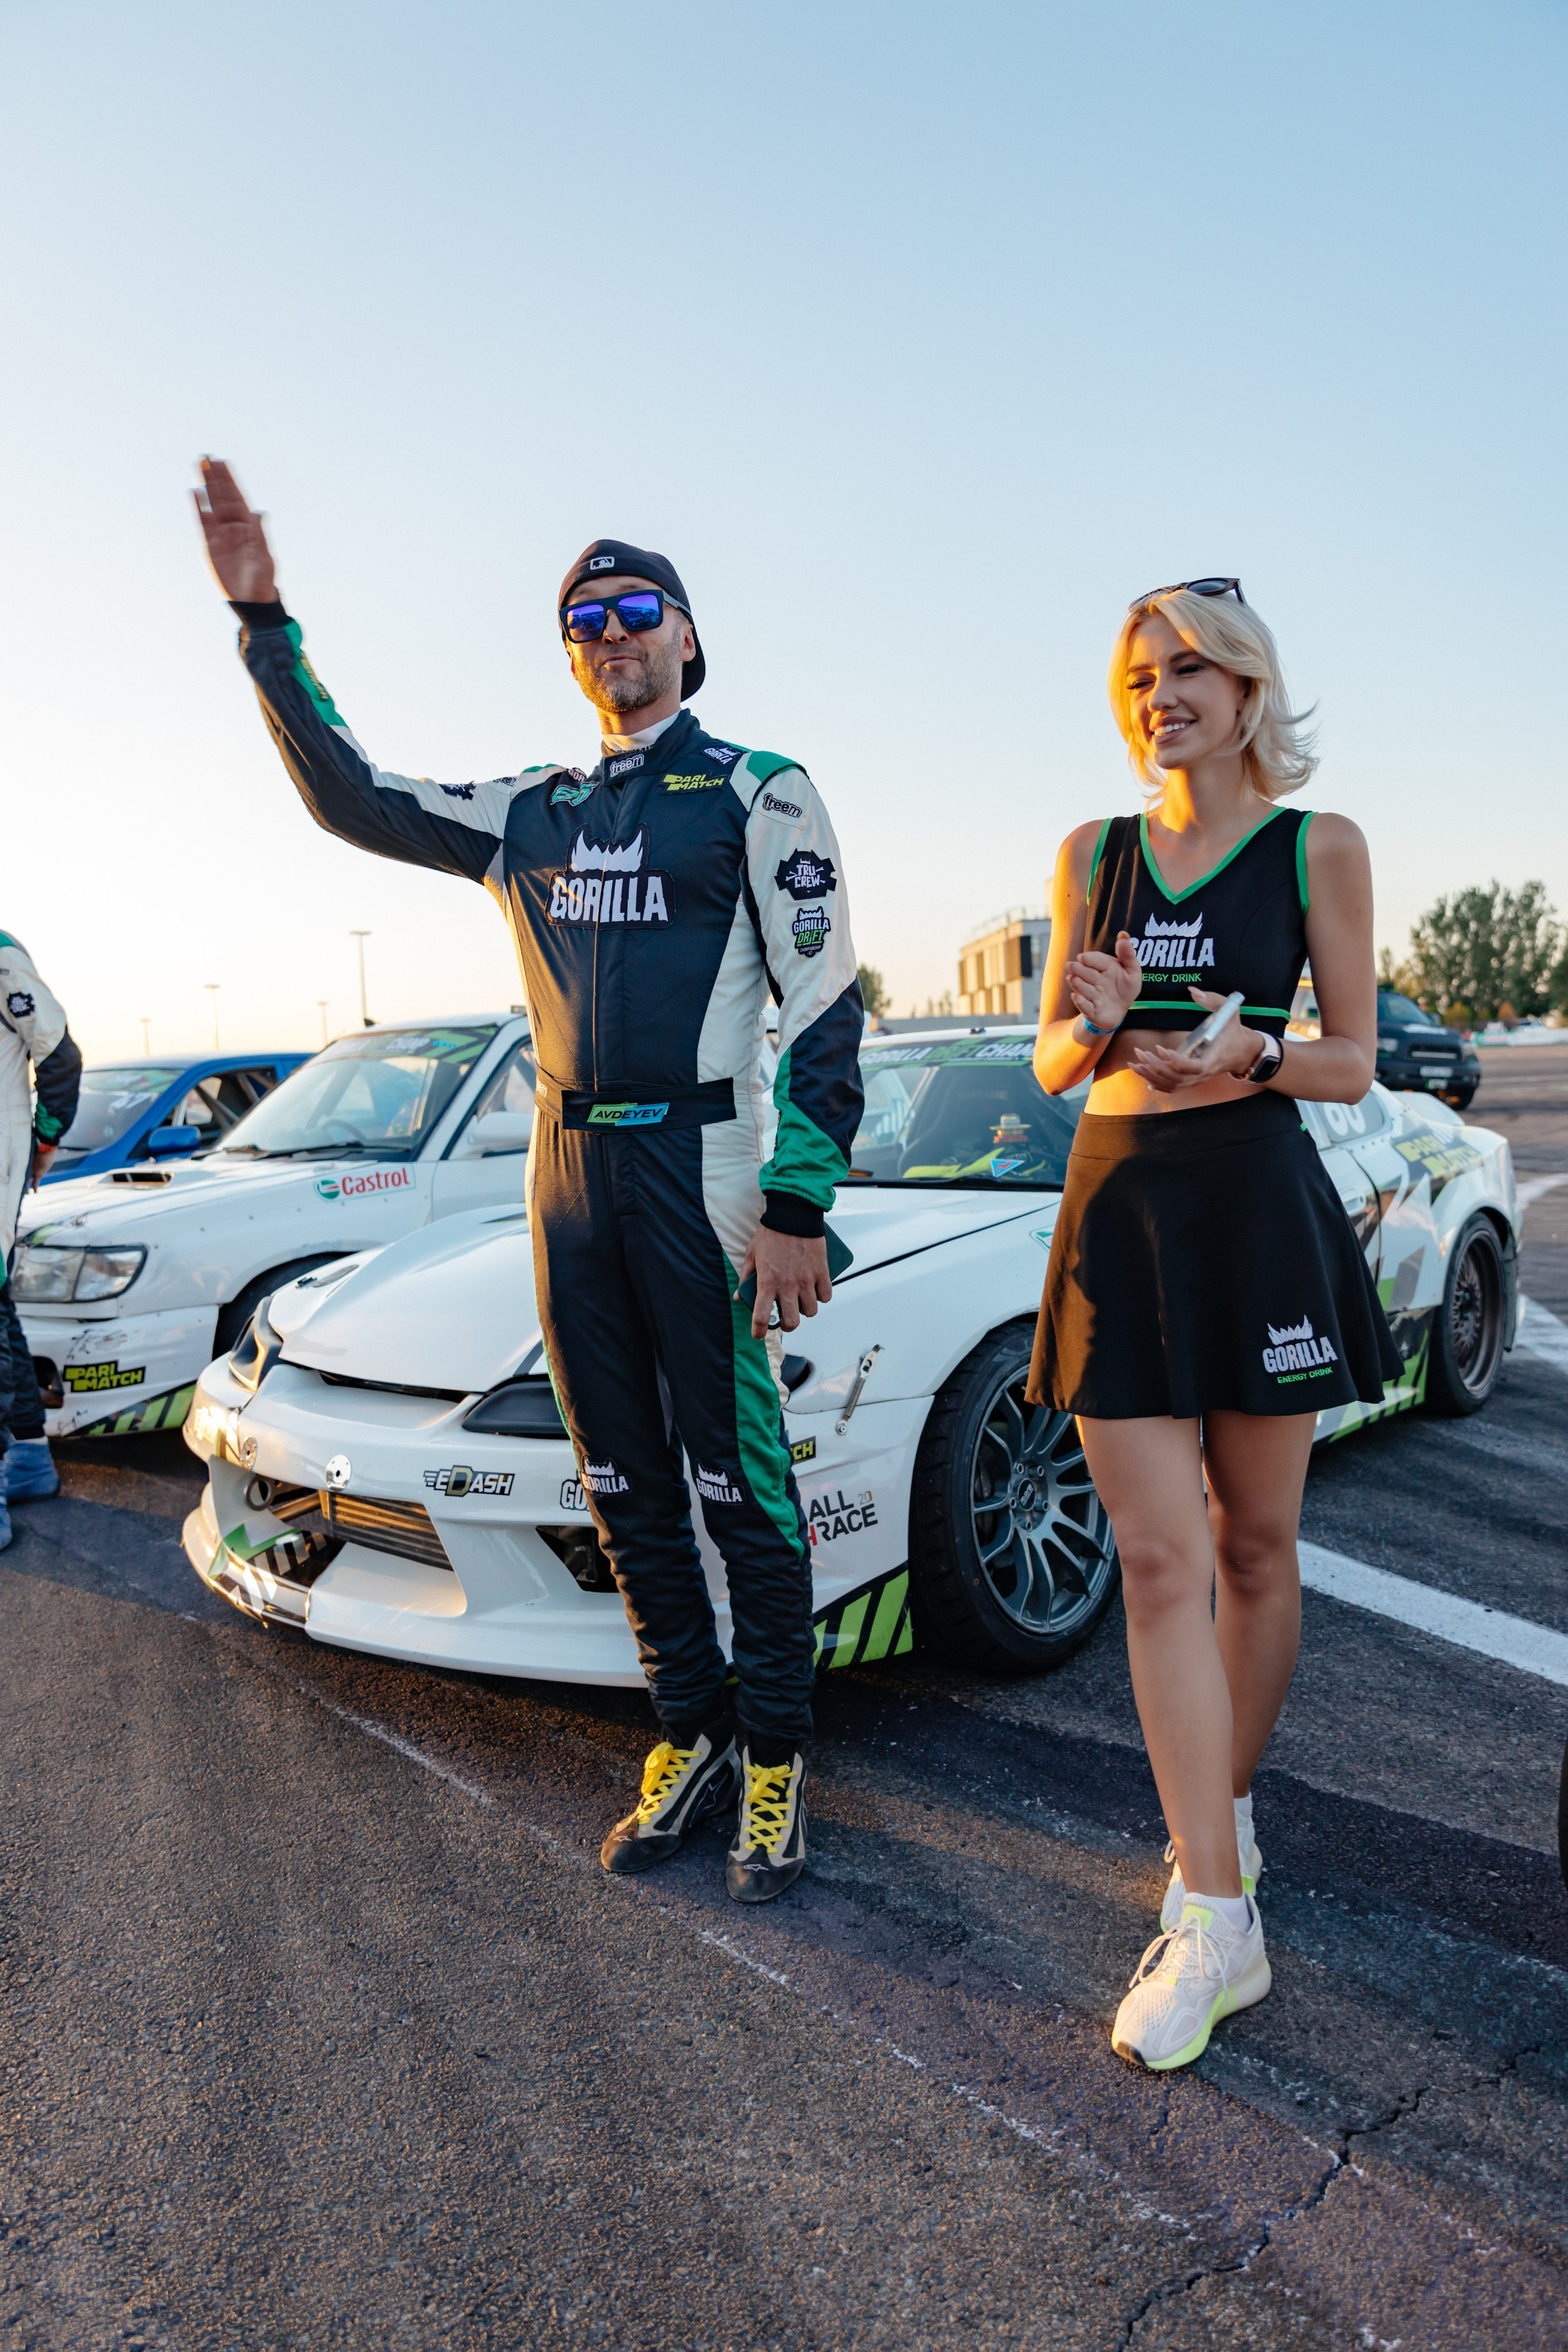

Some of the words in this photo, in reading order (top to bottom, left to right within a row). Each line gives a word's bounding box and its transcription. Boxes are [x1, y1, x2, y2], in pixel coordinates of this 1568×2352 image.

[610, 754, 644, 777] freem
[663, 774, 706, 783] PARI
[667, 777, 724, 791] MATCH
[764, 794, 802, 817] freem
[796, 864, 816, 876] TRU
[794, 875, 820, 888] CREW
[550, 876, 668, 923] GORILLA
[794, 919, 829, 933] GORILLA
[797, 930, 824, 945] DRIFT
[1142, 973, 1169, 982] ERGY
[1172, 973, 1202, 982] DRINK
[594, 1109, 663, 1118] AVDEYEV
[342, 1167, 410, 1196] Castrol
[1262, 1336, 1338, 1373] GORILLA
[66, 1363, 116, 1380] PARI
[73, 1370, 143, 1391] MATCH
[1277, 1373, 1306, 1383] ENERGY
[1309, 1367, 1333, 1378] DRINK
[791, 1441, 813, 1460] CH
[582, 1474, 629, 1493] GORILLA
[696, 1477, 742, 1502] GORILLA
[560, 1481, 589, 1510] GO
[809, 1490, 854, 1523] ALL
